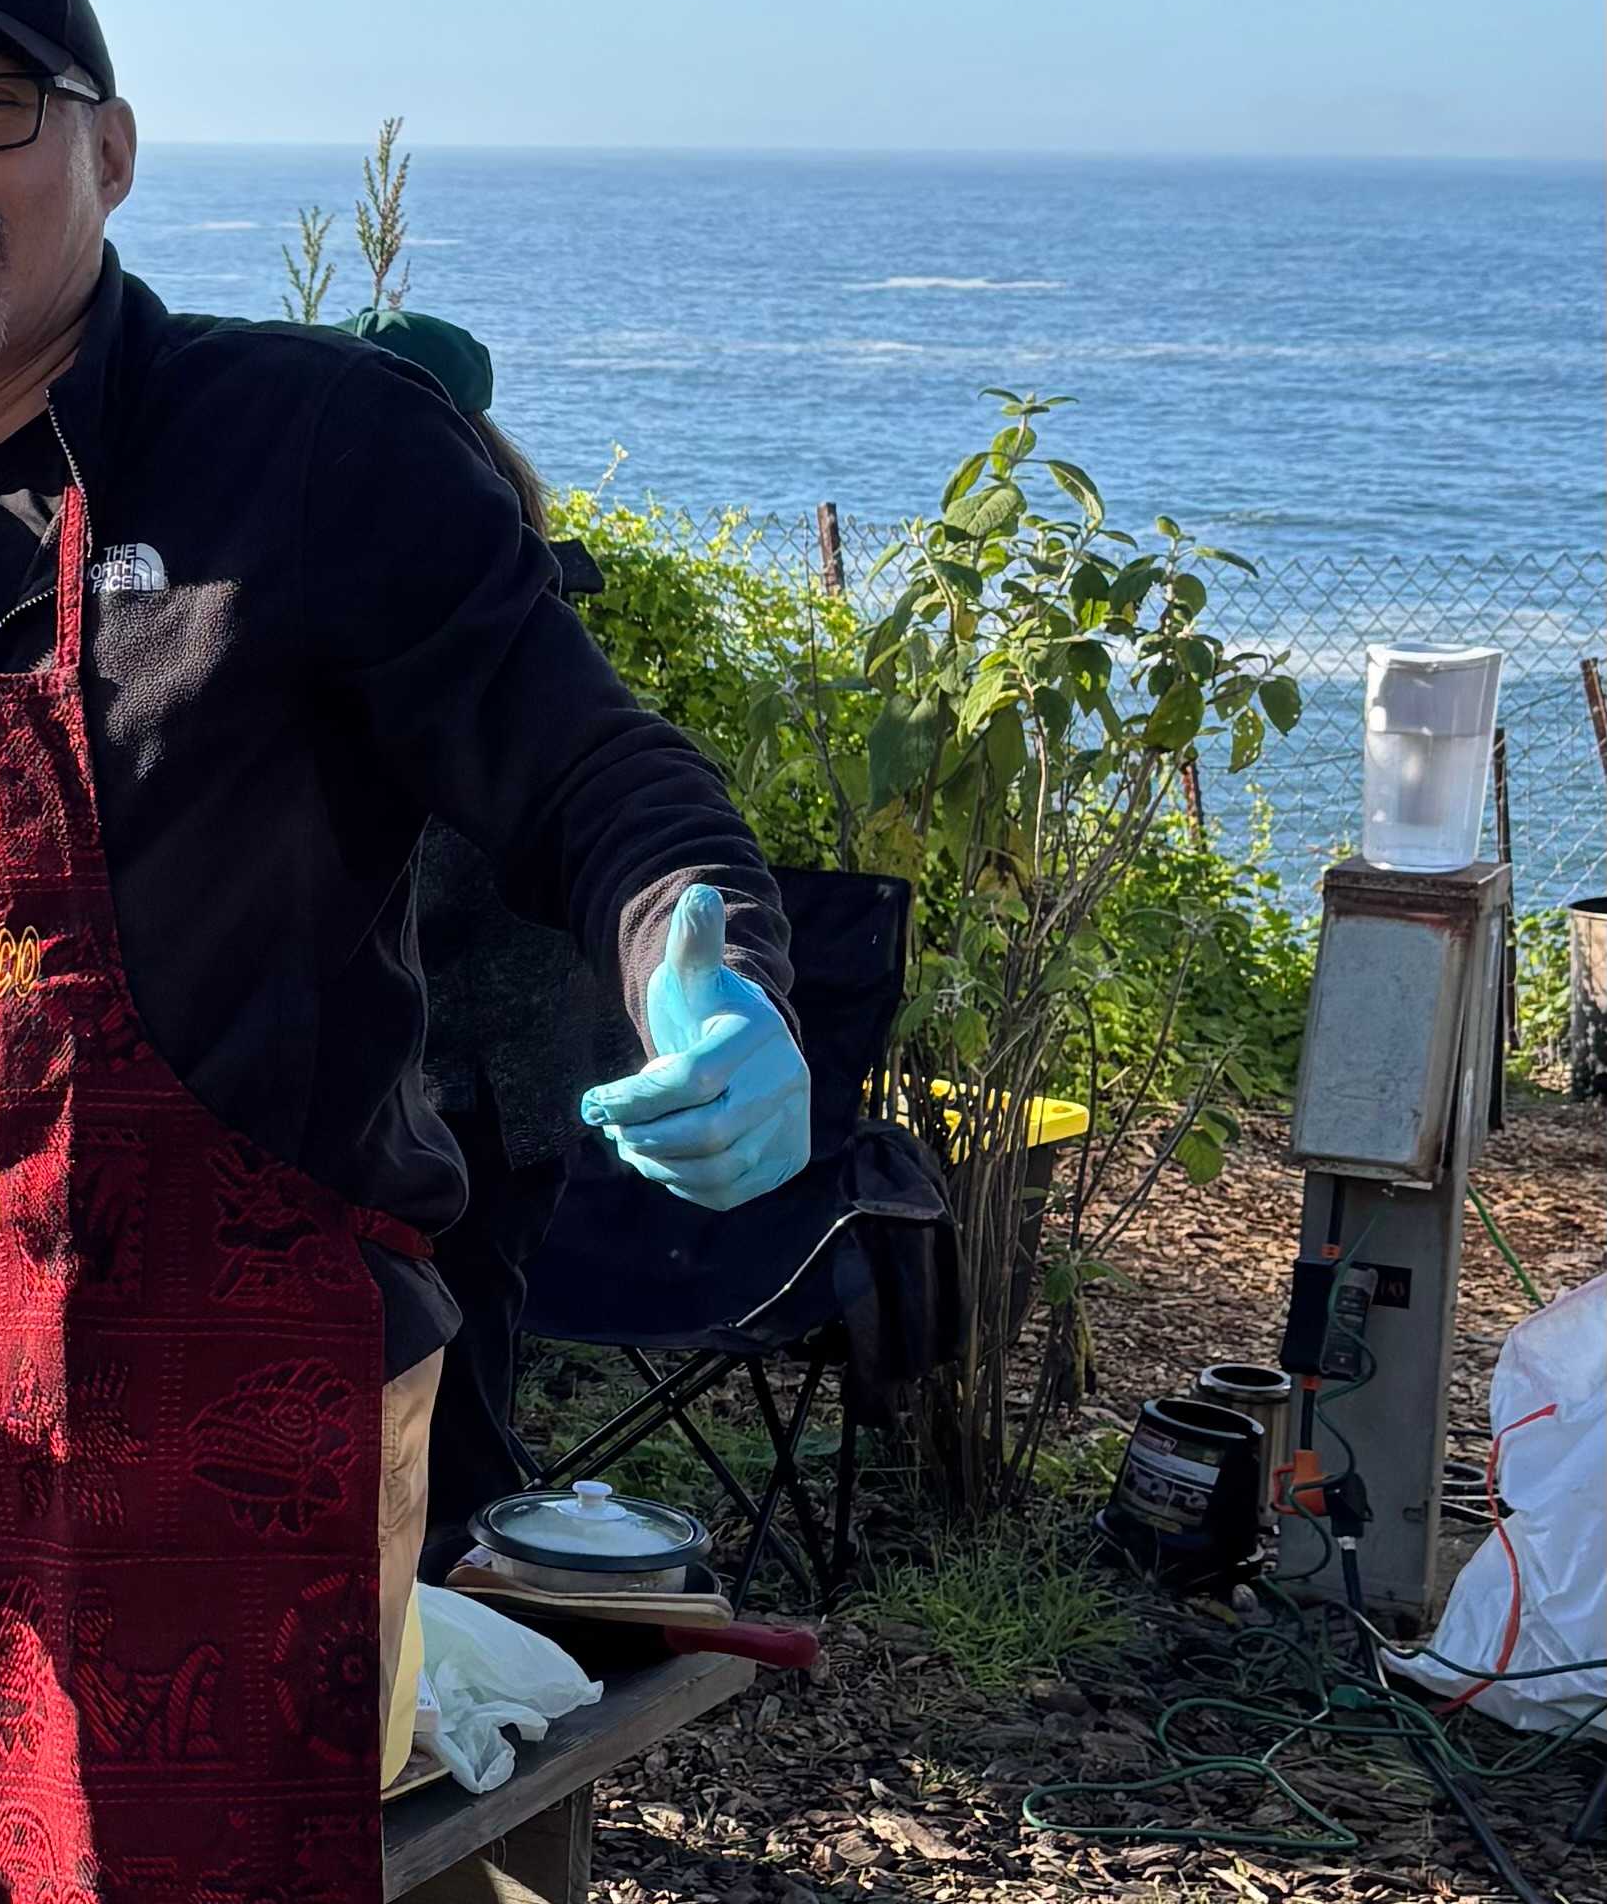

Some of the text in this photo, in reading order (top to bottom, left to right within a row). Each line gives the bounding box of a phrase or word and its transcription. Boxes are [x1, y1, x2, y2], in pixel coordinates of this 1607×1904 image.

[103, 543, 136, 562] THE
[87, 558, 134, 581] ORTH
[92, 575, 133, 594] FACE
